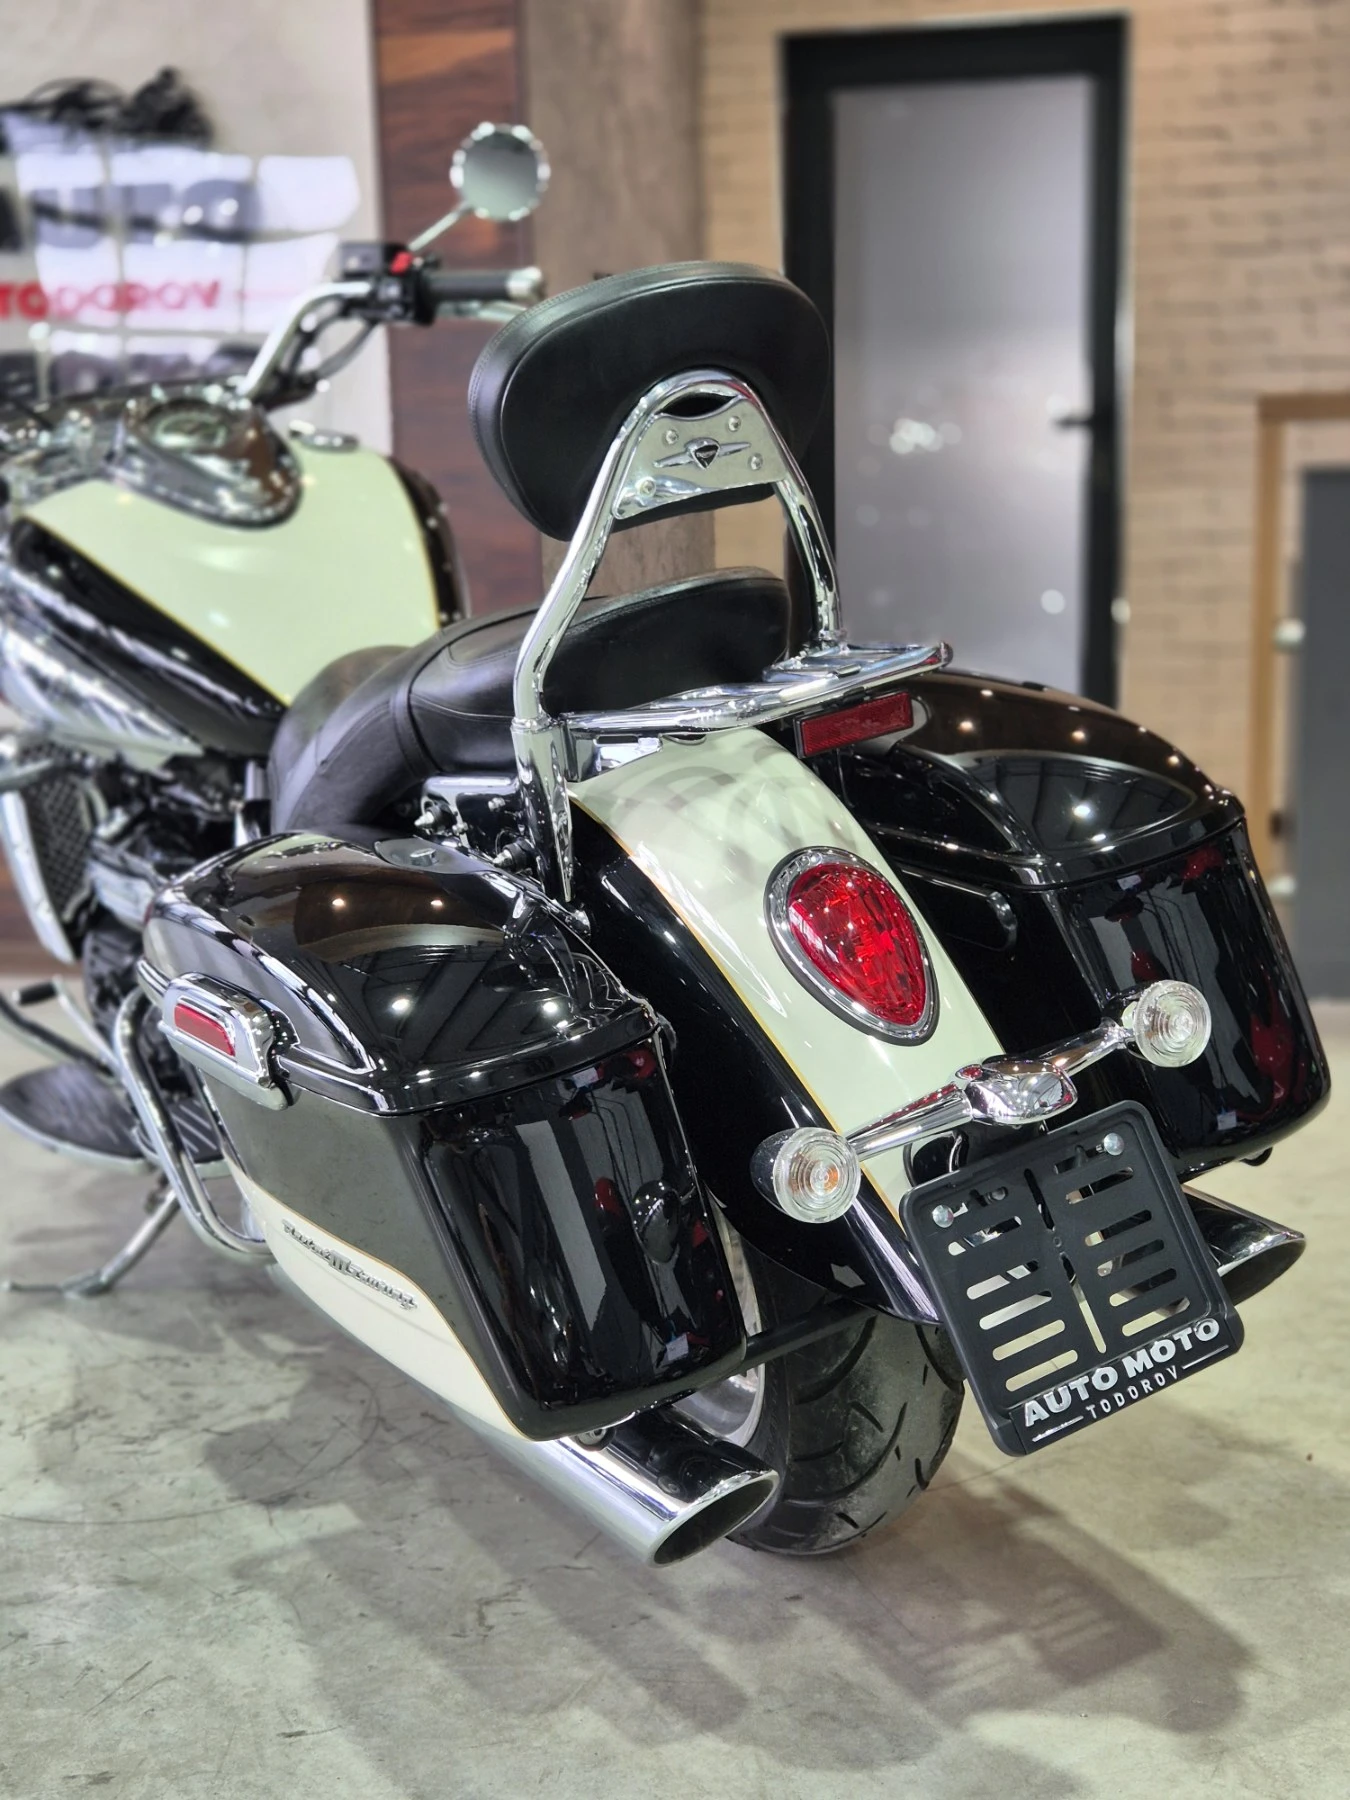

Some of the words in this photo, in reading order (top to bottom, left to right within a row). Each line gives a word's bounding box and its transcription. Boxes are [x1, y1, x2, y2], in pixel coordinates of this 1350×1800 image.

[1024, 1366, 1119, 1427] AUTO
[1121, 1318, 1220, 1378] MOTO
[1086, 1365, 1179, 1419] TODOROV
